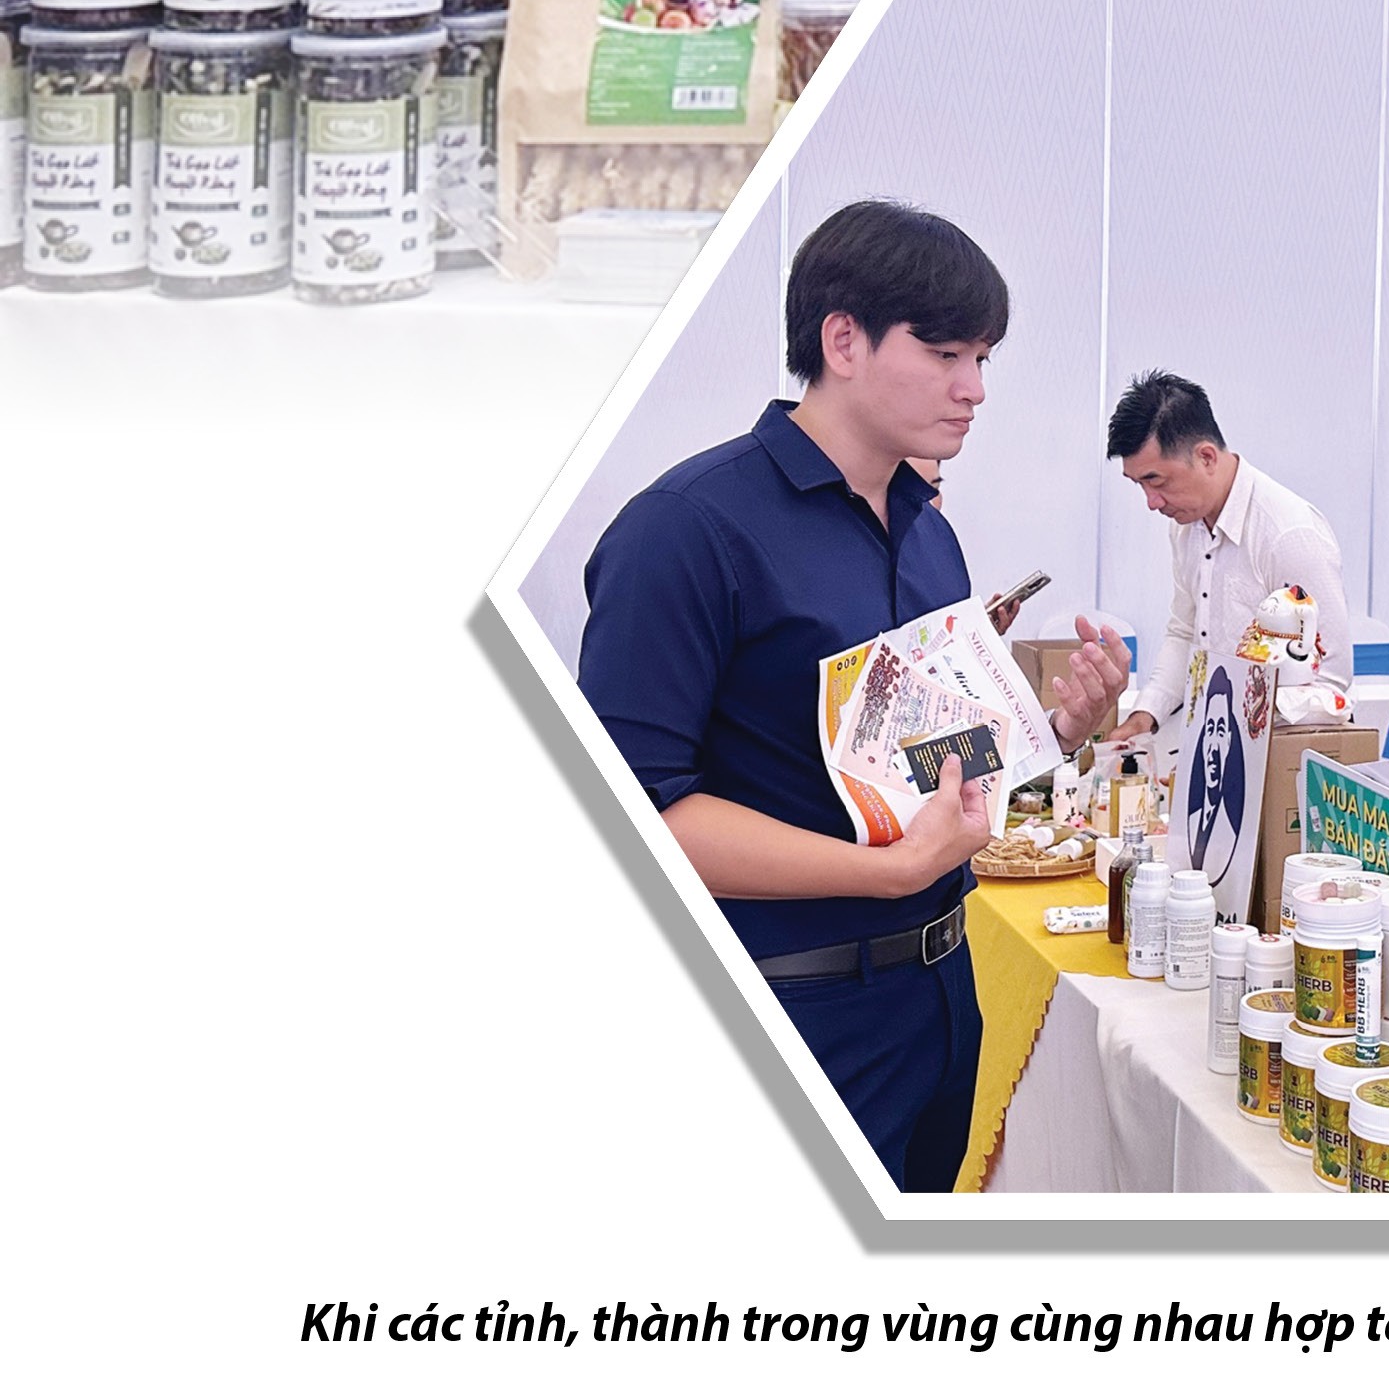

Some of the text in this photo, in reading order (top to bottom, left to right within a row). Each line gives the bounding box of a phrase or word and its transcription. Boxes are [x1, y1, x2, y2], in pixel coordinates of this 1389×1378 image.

[991, 668, 1014, 703] MINH
[1322, 781, 1359, 820] MUA
[1325, 818, 1359, 855] BÁN
[1357, 978, 1366, 1034] BB HERB
[1288, 1096, 1315, 1112] HER
